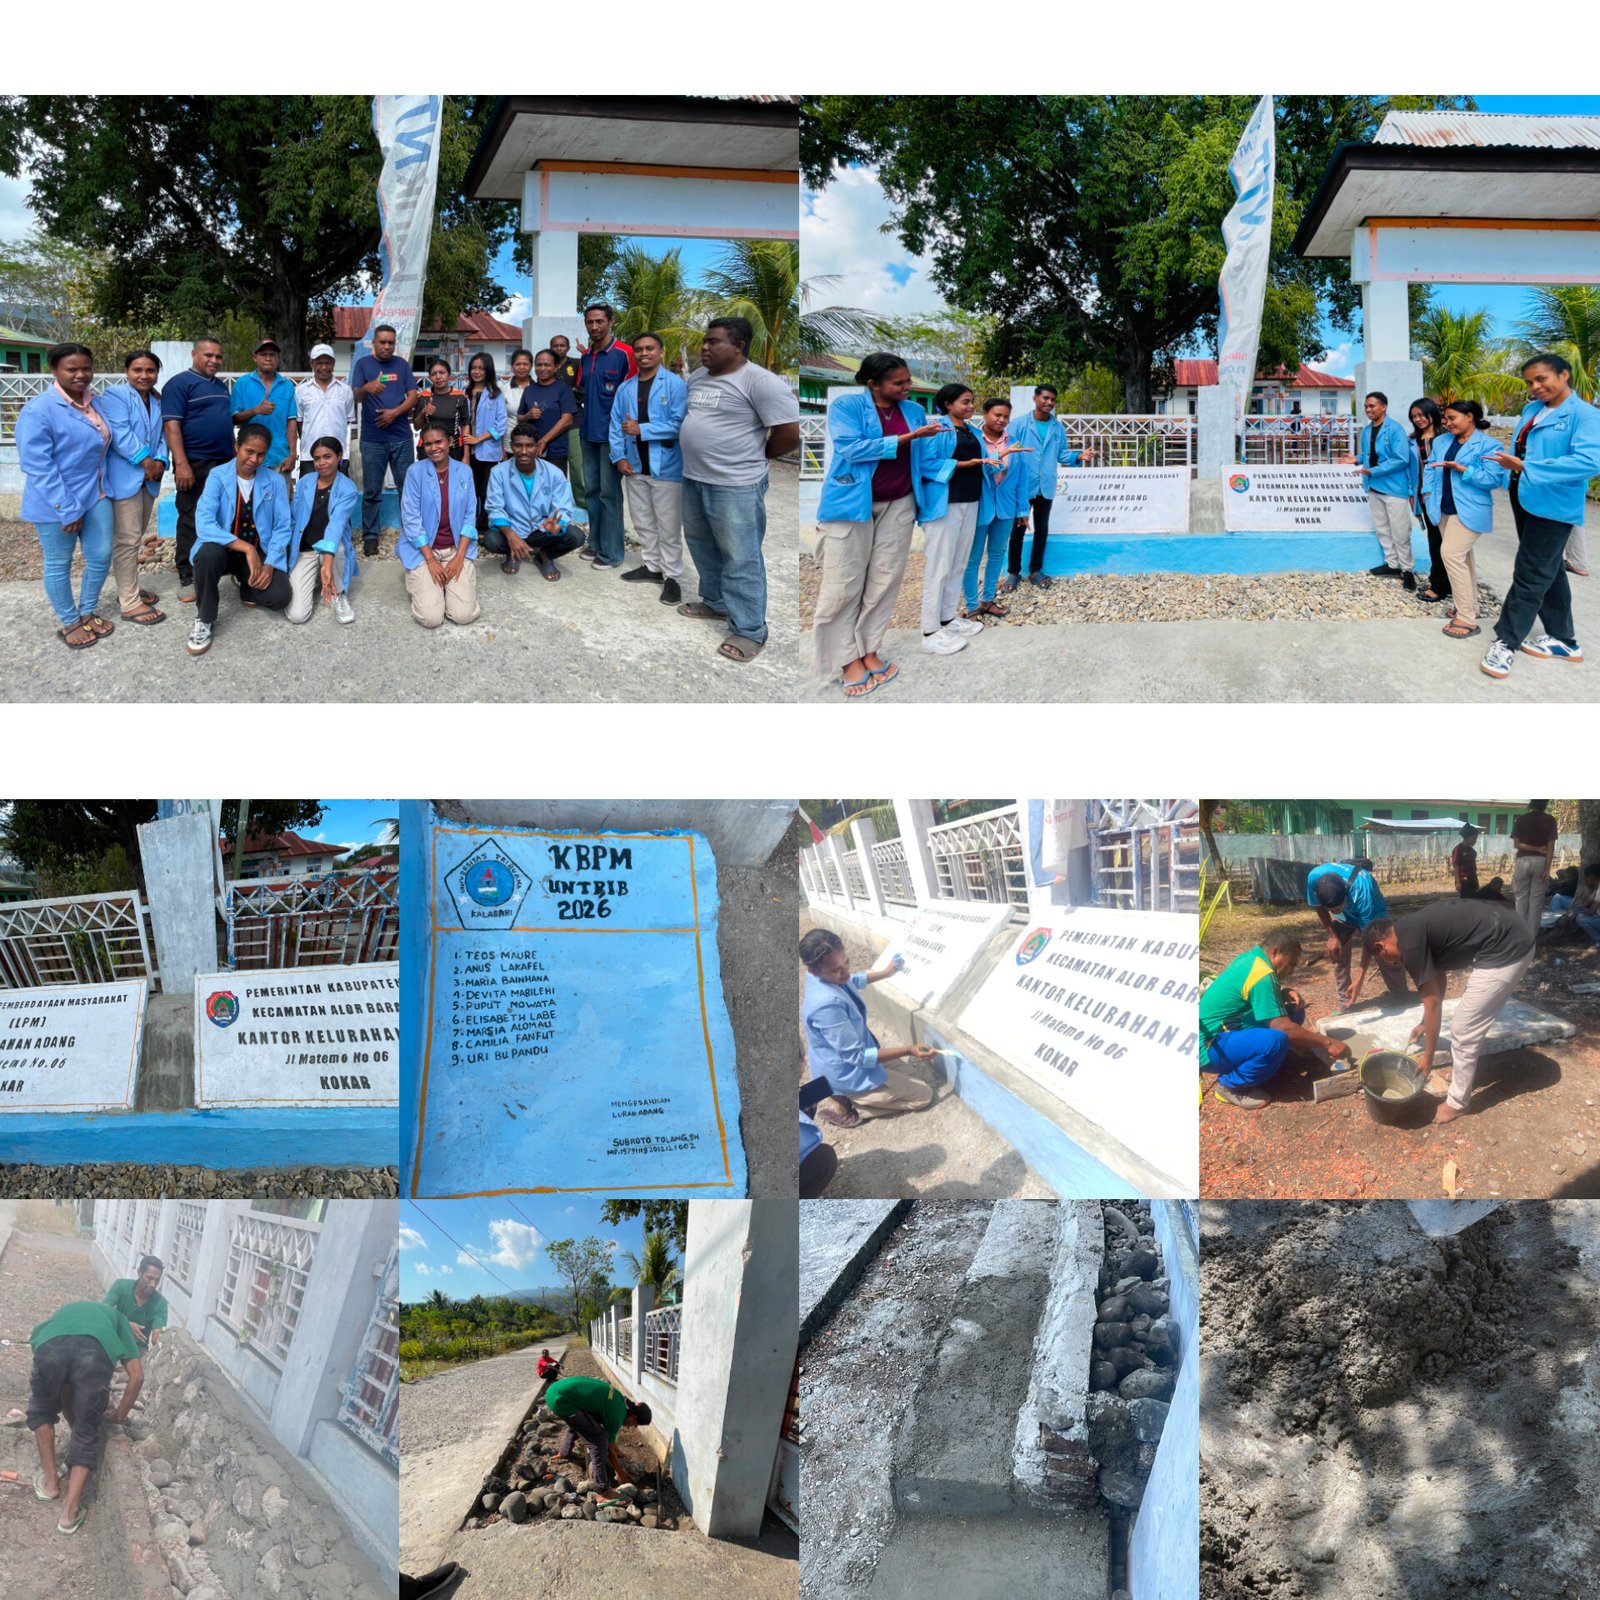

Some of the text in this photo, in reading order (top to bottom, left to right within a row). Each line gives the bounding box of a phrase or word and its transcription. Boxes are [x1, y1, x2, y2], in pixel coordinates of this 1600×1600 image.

[1249, 495, 1285, 503] KANTOR
[1288, 495, 1340, 503] KELURAHAN
[548, 844, 633, 872] KBPM
[548, 879, 629, 898] UNTRIB
[471, 909, 513, 919] KALABAHI
[557, 898, 612, 920] 2026
[1059, 930, 1138, 950] PEMERINTAH
[465, 951, 496, 960] TEOS
[501, 950, 537, 960] MAURE
[465, 963, 491, 974] ANUS
[500, 962, 545, 972] LAKAFEL
[1046, 952, 1117, 981] KECAMATAN
[1114, 970, 1159, 992] ALOR
[465, 978, 498, 987] MARIA
[246, 983, 322, 998] PEMERINTAH
[466, 990, 507, 1000] DEVITA
[67, 994, 128, 1007] MASYARAKAT
[466, 1001, 501, 1011] PUPUT
[510, 999, 556, 1009] MOWATA
[252, 1005, 327, 1018] KECAMATAN
[331, 1003, 363, 1016] ALOR
[465, 1013, 526, 1025] ELISABETH
[530, 1010, 556, 1021] LABE
[1016, 974, 1066, 1003] KANTOR
[1064, 992, 1180, 1047] KELURAHAN
[510, 1021, 552, 1032] ALOMAU
[34, 1036, 76, 1050] ADANG
[238, 1031, 301, 1046] KANTOR
[465, 1036, 509, 1049] CAMILIA
[516, 1030, 555, 1043] FANFUT
[1039, 1013, 1085, 1041] Matemo
[1084, 1033, 1105, 1050] No
[1103, 1042, 1128, 1060] 06
[299, 1052, 348, 1065] Matemo
[353, 1052, 369, 1064] No
[373, 1051, 389, 1063] 06
[467, 1053, 489, 1064] URI
[1034, 1042, 1079, 1078] KOKAR
[319, 1076, 371, 1090] KOKAR
[612, 1137, 651, 1147] SUBROTO
